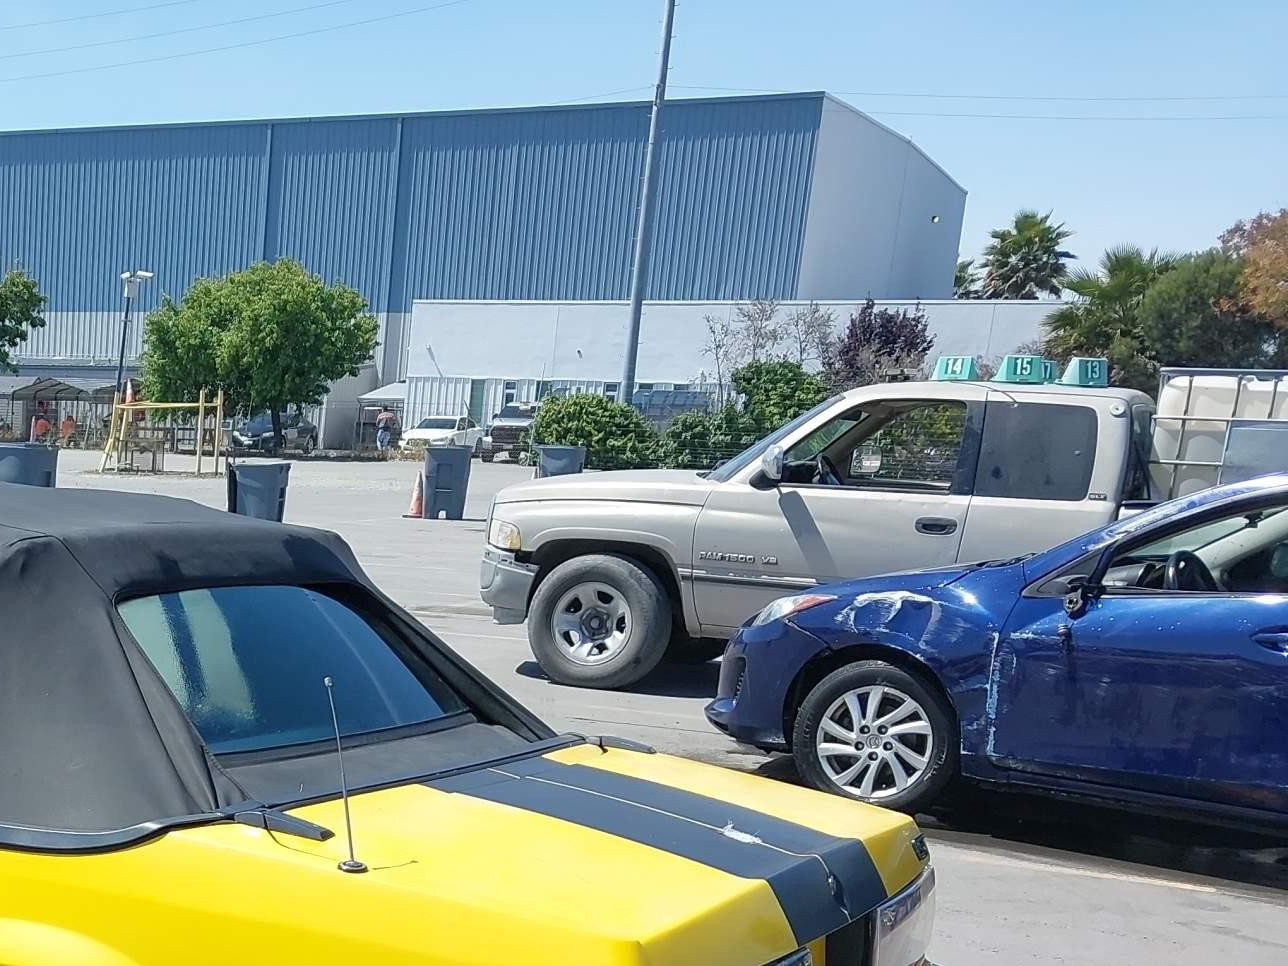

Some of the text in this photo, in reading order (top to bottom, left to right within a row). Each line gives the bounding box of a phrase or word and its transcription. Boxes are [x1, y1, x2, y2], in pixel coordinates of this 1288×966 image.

[947, 358, 963, 375] 14
[1016, 357, 1031, 375] 15
[1087, 361, 1100, 378] 13
[724, 553, 755, 563] 1500
